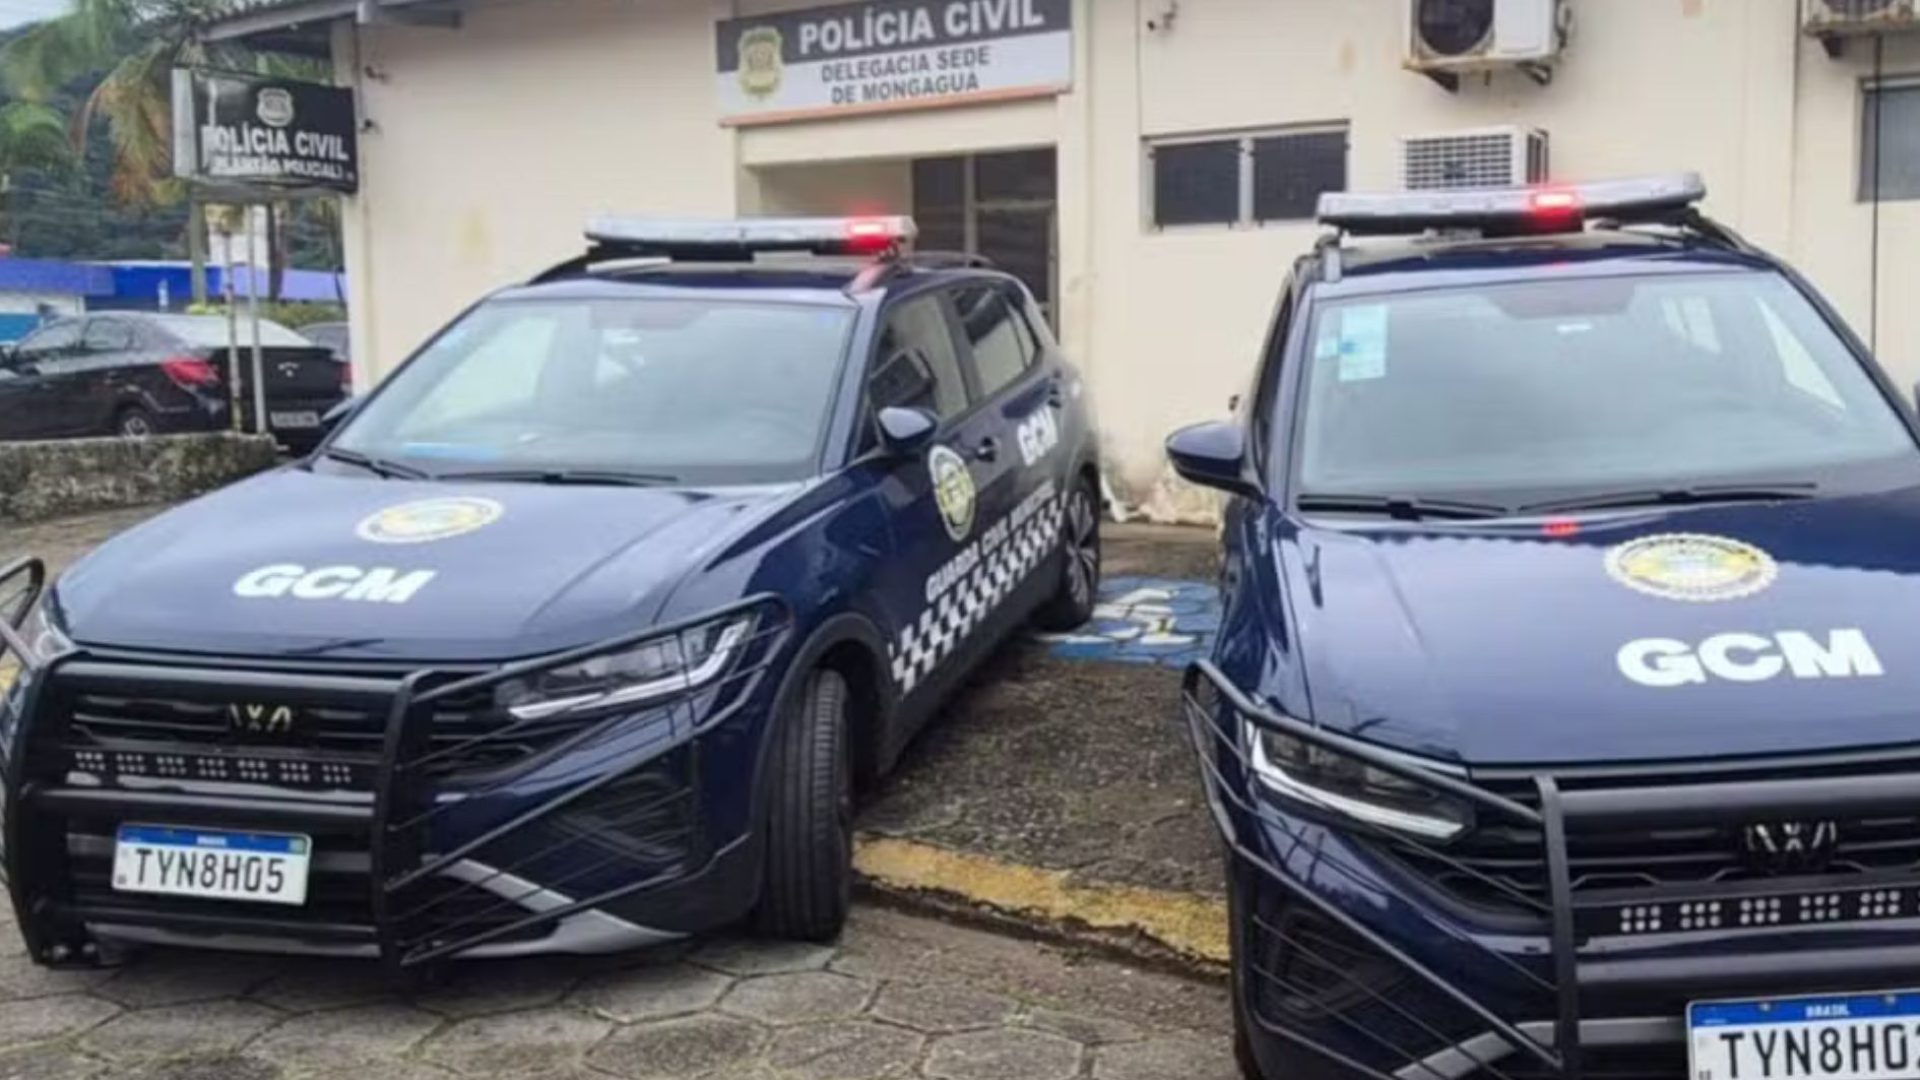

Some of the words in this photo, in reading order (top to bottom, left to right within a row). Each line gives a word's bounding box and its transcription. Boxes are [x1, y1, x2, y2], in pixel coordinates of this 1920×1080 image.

[799, 10, 935, 54] POLÍCIA
[944, 0, 1045, 36] CIVIL
[821, 51, 931, 83] DELEGACIA
[936, 46, 992, 71] SEDE
[831, 86, 856, 105] DE
[294, 130, 350, 161] CIVIL
[233, 562, 438, 604] GCM
[1616, 627, 1885, 686] GCM
[136, 847, 286, 893] TYN8H05
[1719, 1023, 1920, 1079] TYN8H0
